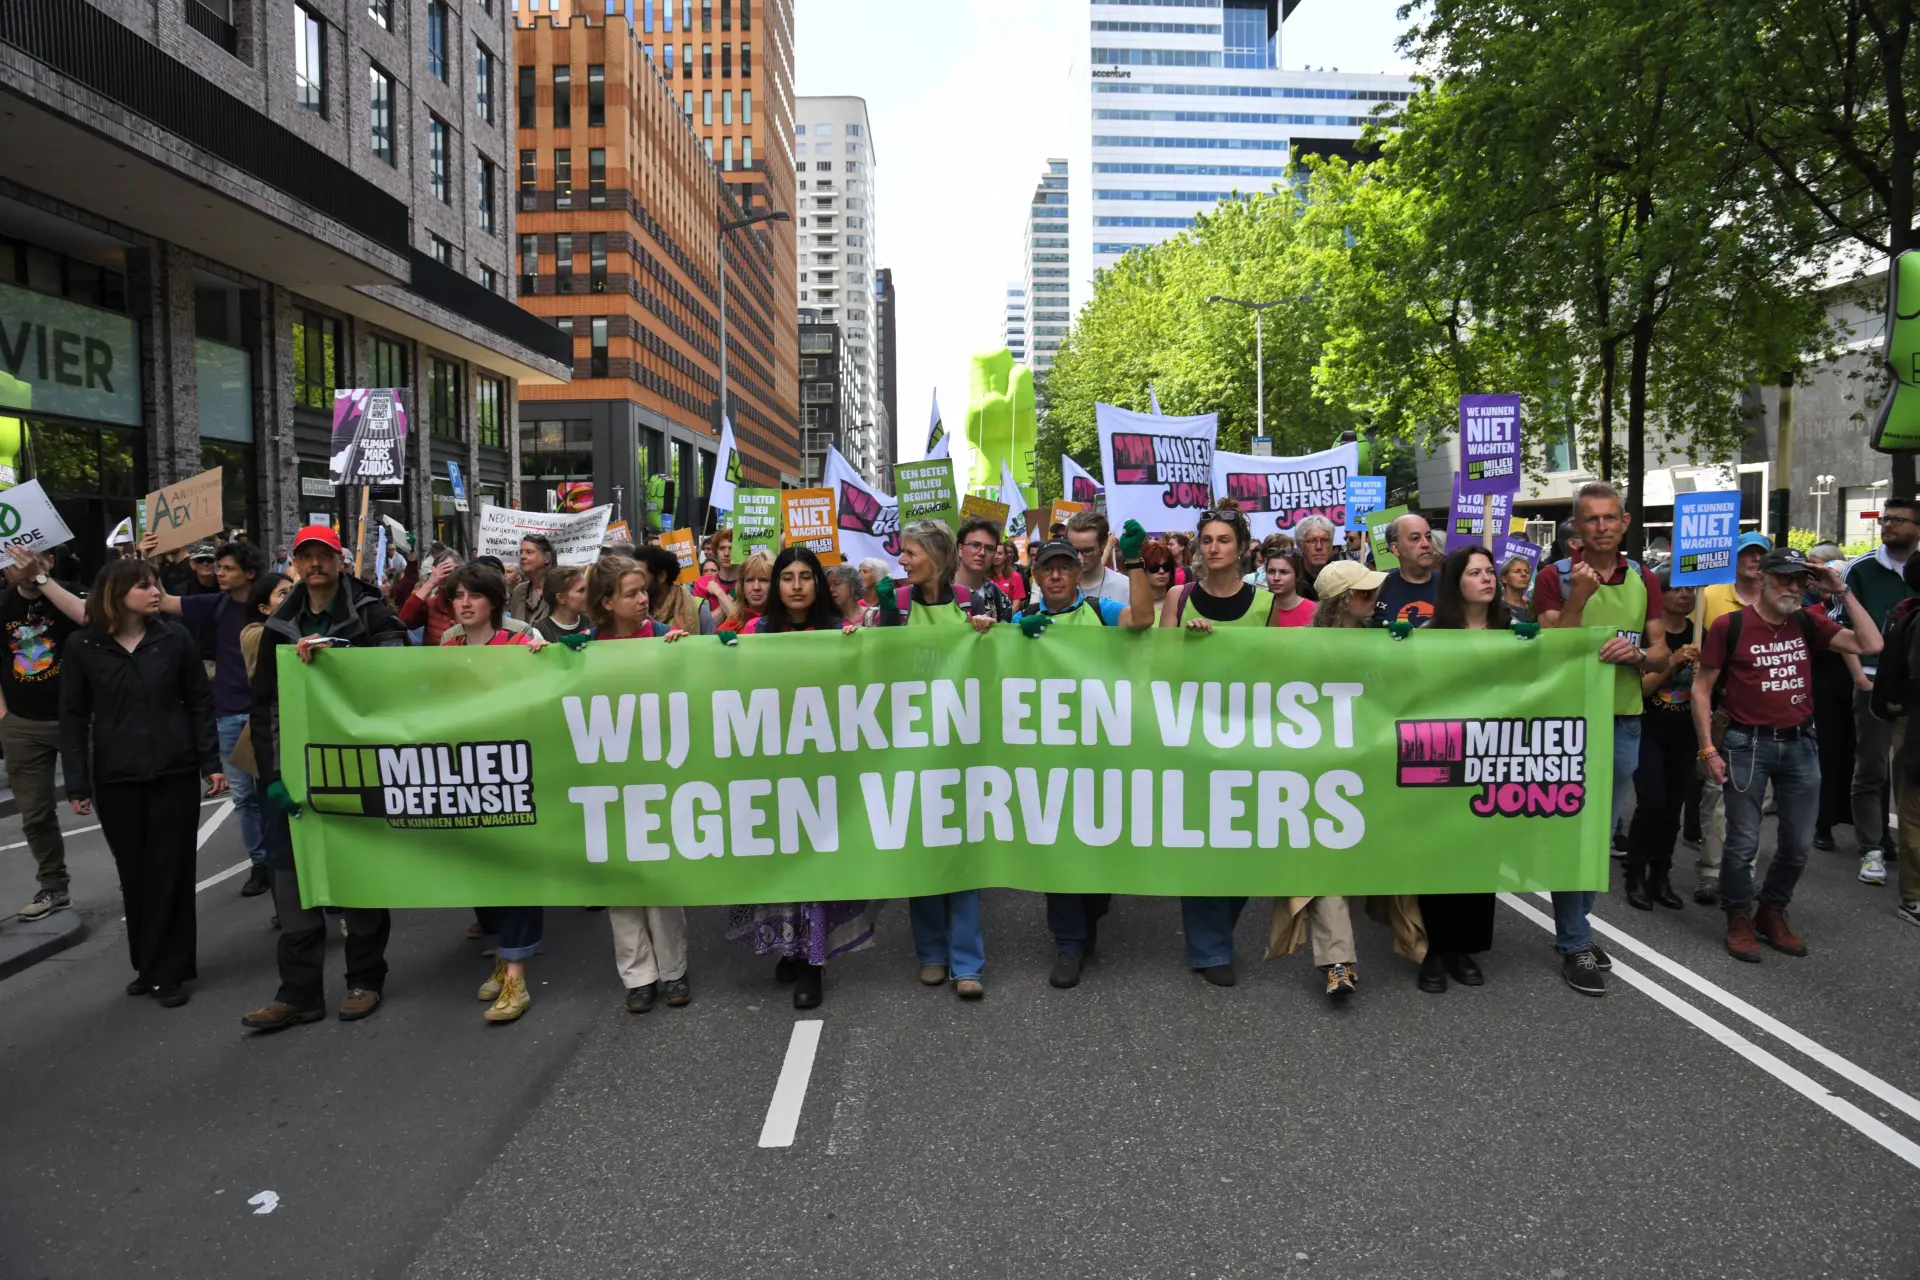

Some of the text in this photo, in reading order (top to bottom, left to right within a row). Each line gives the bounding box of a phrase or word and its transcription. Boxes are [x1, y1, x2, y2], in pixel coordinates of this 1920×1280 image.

[1092, 68, 1131, 78] accenture
[1466, 406, 1514, 416] WE KUNNEN
[1466, 417, 1514, 442] NIET
[360, 438, 394, 448] KLIMAAT
[1468, 442, 1514, 455] WACHTEN
[364, 448, 390, 460] MARS
[1152, 436, 1210, 465] MILIEU
[357, 460, 394, 476] ZUIDAS
[1484, 457, 1513, 470] MILIEU
[901, 466, 948, 480] EEN BETER
[1484, 466, 1514, 478] DEFENSIE
[910, 478, 942, 490] MILIEU
[1268, 468, 1346, 494] MILIEU
[738, 494, 776, 504] EEN BETER
[799, 498, 830, 506] KUNNEN
[903, 489, 950, 502] BEGINT BIJ
[1270, 489, 1346, 510] DEFENSIE
[744, 506, 768, 514] MILIEU
[906, 504, 952, 519] EXXONMOBIL
[1682, 502, 1734, 514] WE KUNNEN
[764, 516, 775, 526] BIJ
[788, 506, 830, 526] NIET
[790, 526, 832, 536] WACHTEN
[1681, 513, 1734, 538] NIET
[806, 538, 832, 549] MILIEU
[1680, 537, 1732, 550] WACHTEN
[1516, 545, 1536, 557] BETER
[1697, 550, 1730, 563] MILIEU
[1696, 560, 1729, 570] DEFENSIE
[1750, 637, 1804, 654] CLIMATE
[1752, 650, 1807, 668] JUSTICE
[1770, 664, 1797, 678] FOR
[1761, 678, 1804, 692] PEACE
[562, 678, 1364, 768] WIJ MAKEN EEN VUIST
[1466, 720, 1584, 756] MILIEU
[378, 744, 528, 786] MILIEU
[1464, 756, 1583, 783] DEFENSIE
[384, 784, 532, 815] DEFENSIE
[1473, 783, 1584, 813] JONG
[390, 812, 534, 828] WE KUNNEN NIET WACHTEN
[568, 765, 1366, 862] TEGEN VERVUILERS
